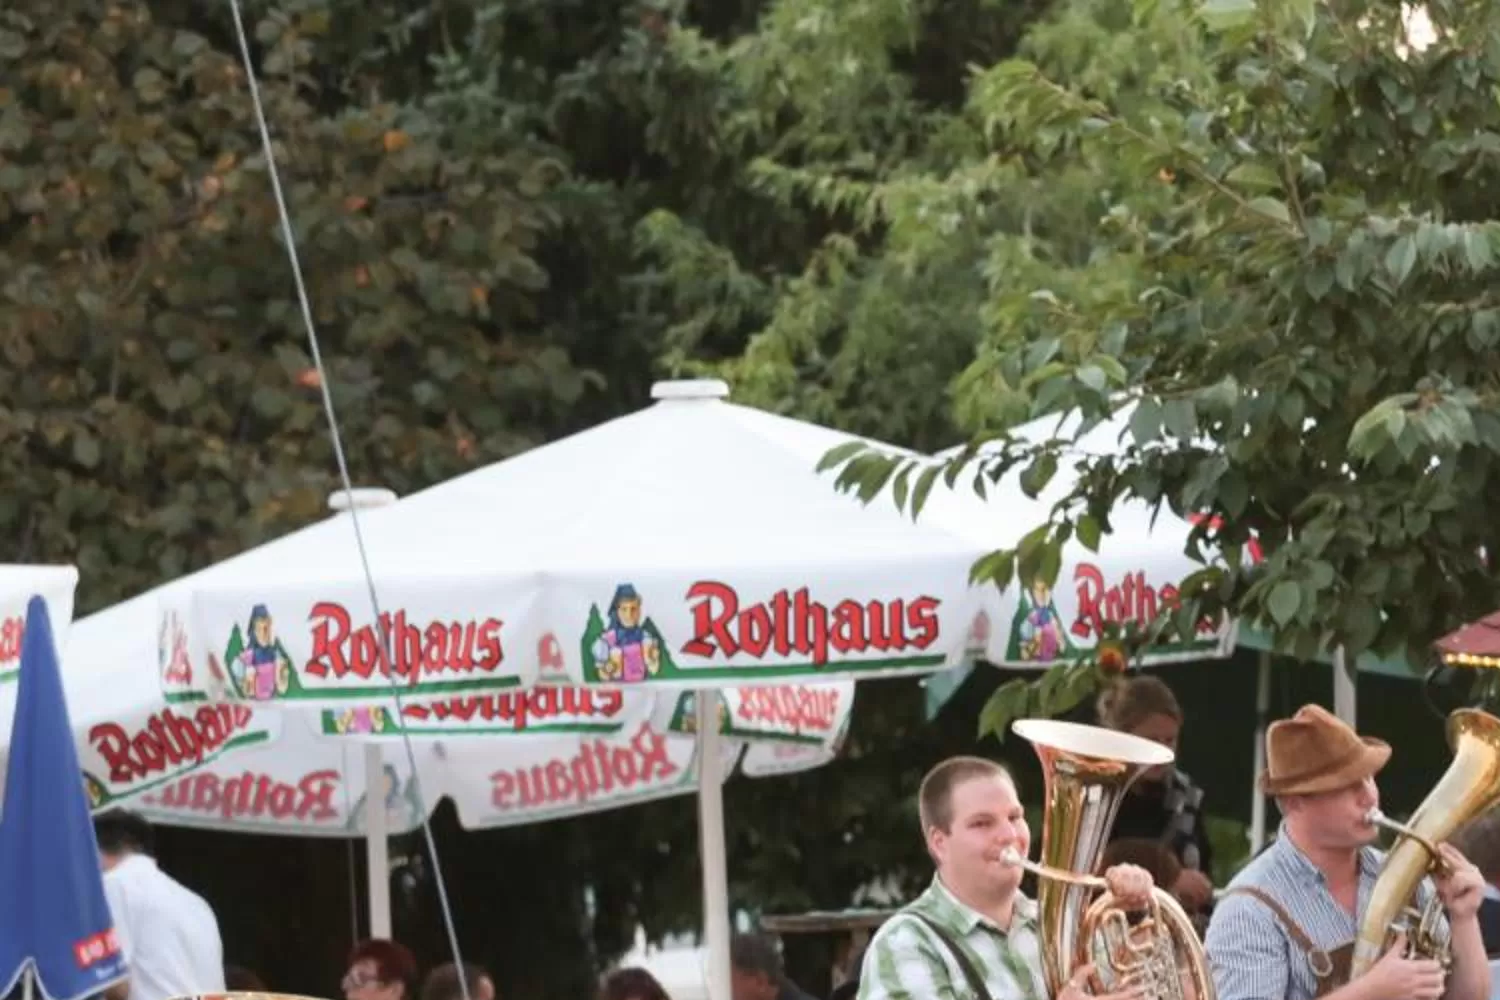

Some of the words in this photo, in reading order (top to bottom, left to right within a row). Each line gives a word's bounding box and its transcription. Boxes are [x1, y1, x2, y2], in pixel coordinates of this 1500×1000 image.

[680, 579, 942, 668] Rothaus
[1070, 562, 1215, 640] Rotha
[304, 600, 505, 687] Rothaus
[401, 686, 623, 730] othaus
